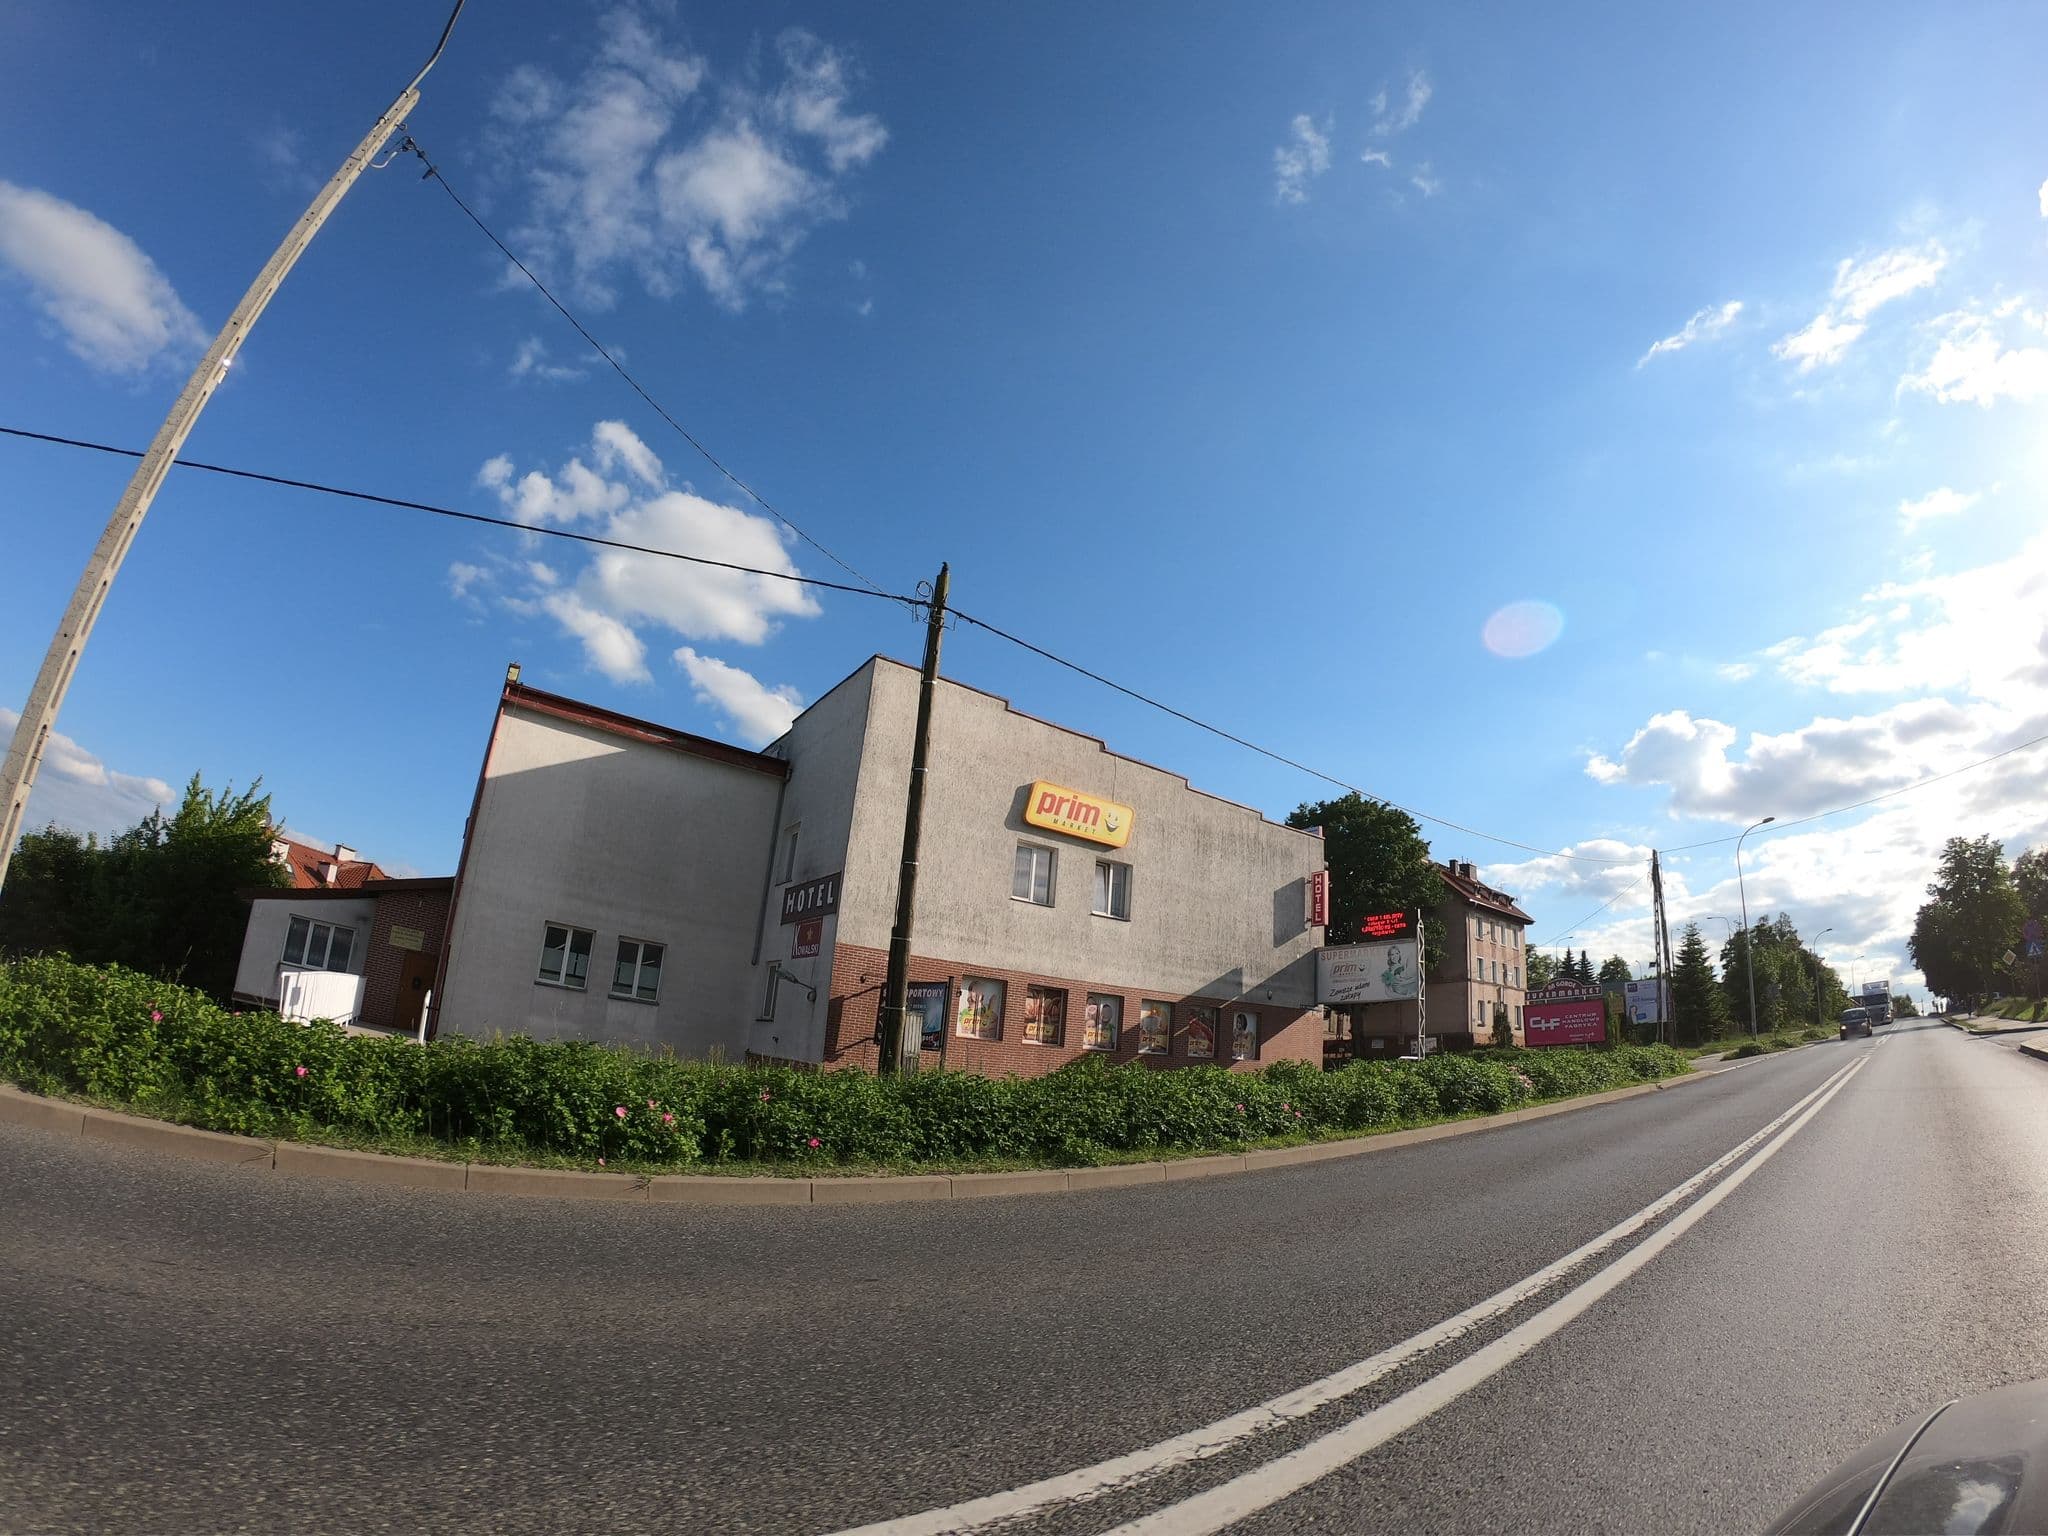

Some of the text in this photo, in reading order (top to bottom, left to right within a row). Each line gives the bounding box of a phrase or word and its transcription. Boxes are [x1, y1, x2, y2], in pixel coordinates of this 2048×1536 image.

[1036, 791, 1101, 827] prim
[1052, 818, 1097, 835] MARKET
[785, 881, 834, 914] HOTEL
[1314, 874, 1322, 921] HOTEL
[1333, 961, 1357, 975] prim
[1527, 987, 1600, 999] SUPERMARKET
